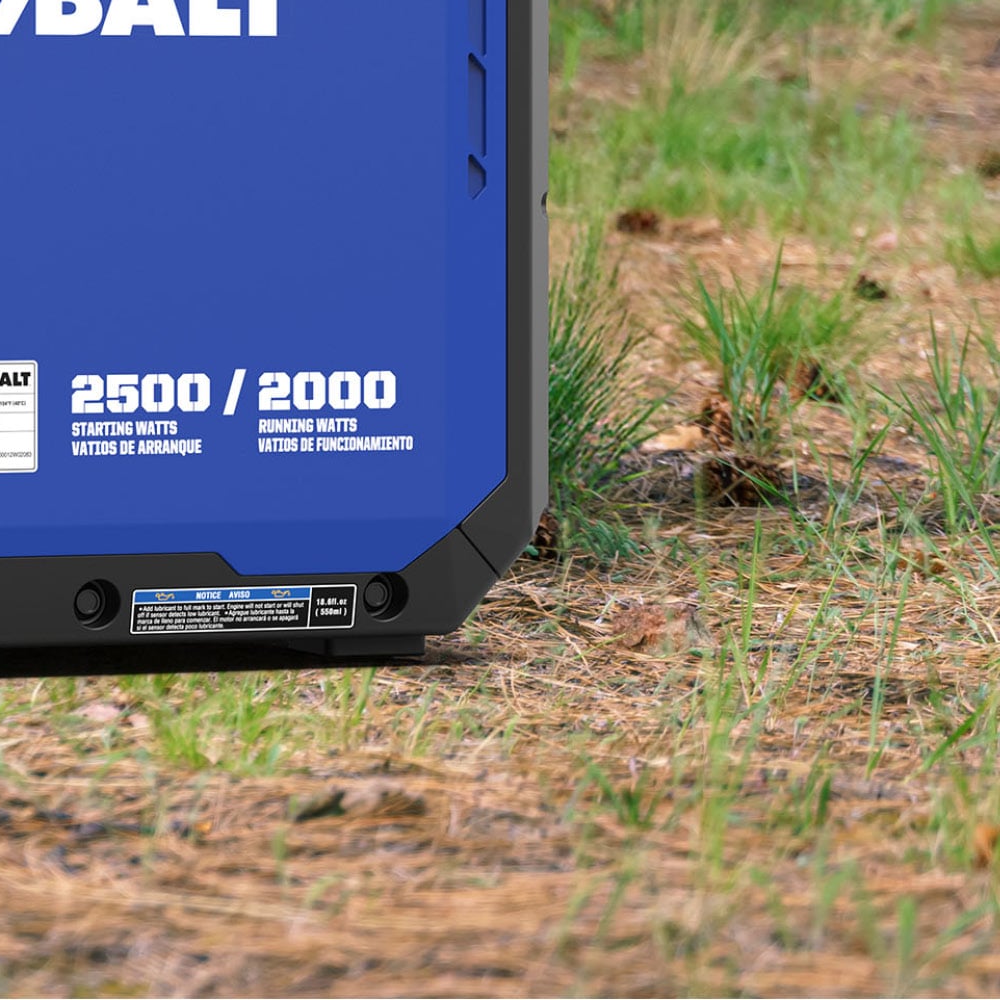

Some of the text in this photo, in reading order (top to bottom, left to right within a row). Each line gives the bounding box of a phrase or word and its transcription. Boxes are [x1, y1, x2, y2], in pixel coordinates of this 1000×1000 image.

[71, 369, 396, 415] 2500 / 2000
[72, 420, 178, 436] STARTING WATTS
[259, 418, 357, 433] RUNNING WATTS
[72, 439, 202, 456] VATIOS DE ARRANQUE
[258, 436, 413, 453] VATIOS DE FUNCIONAMIENTO
[196, 591, 250, 600] NOTICE AVISO
